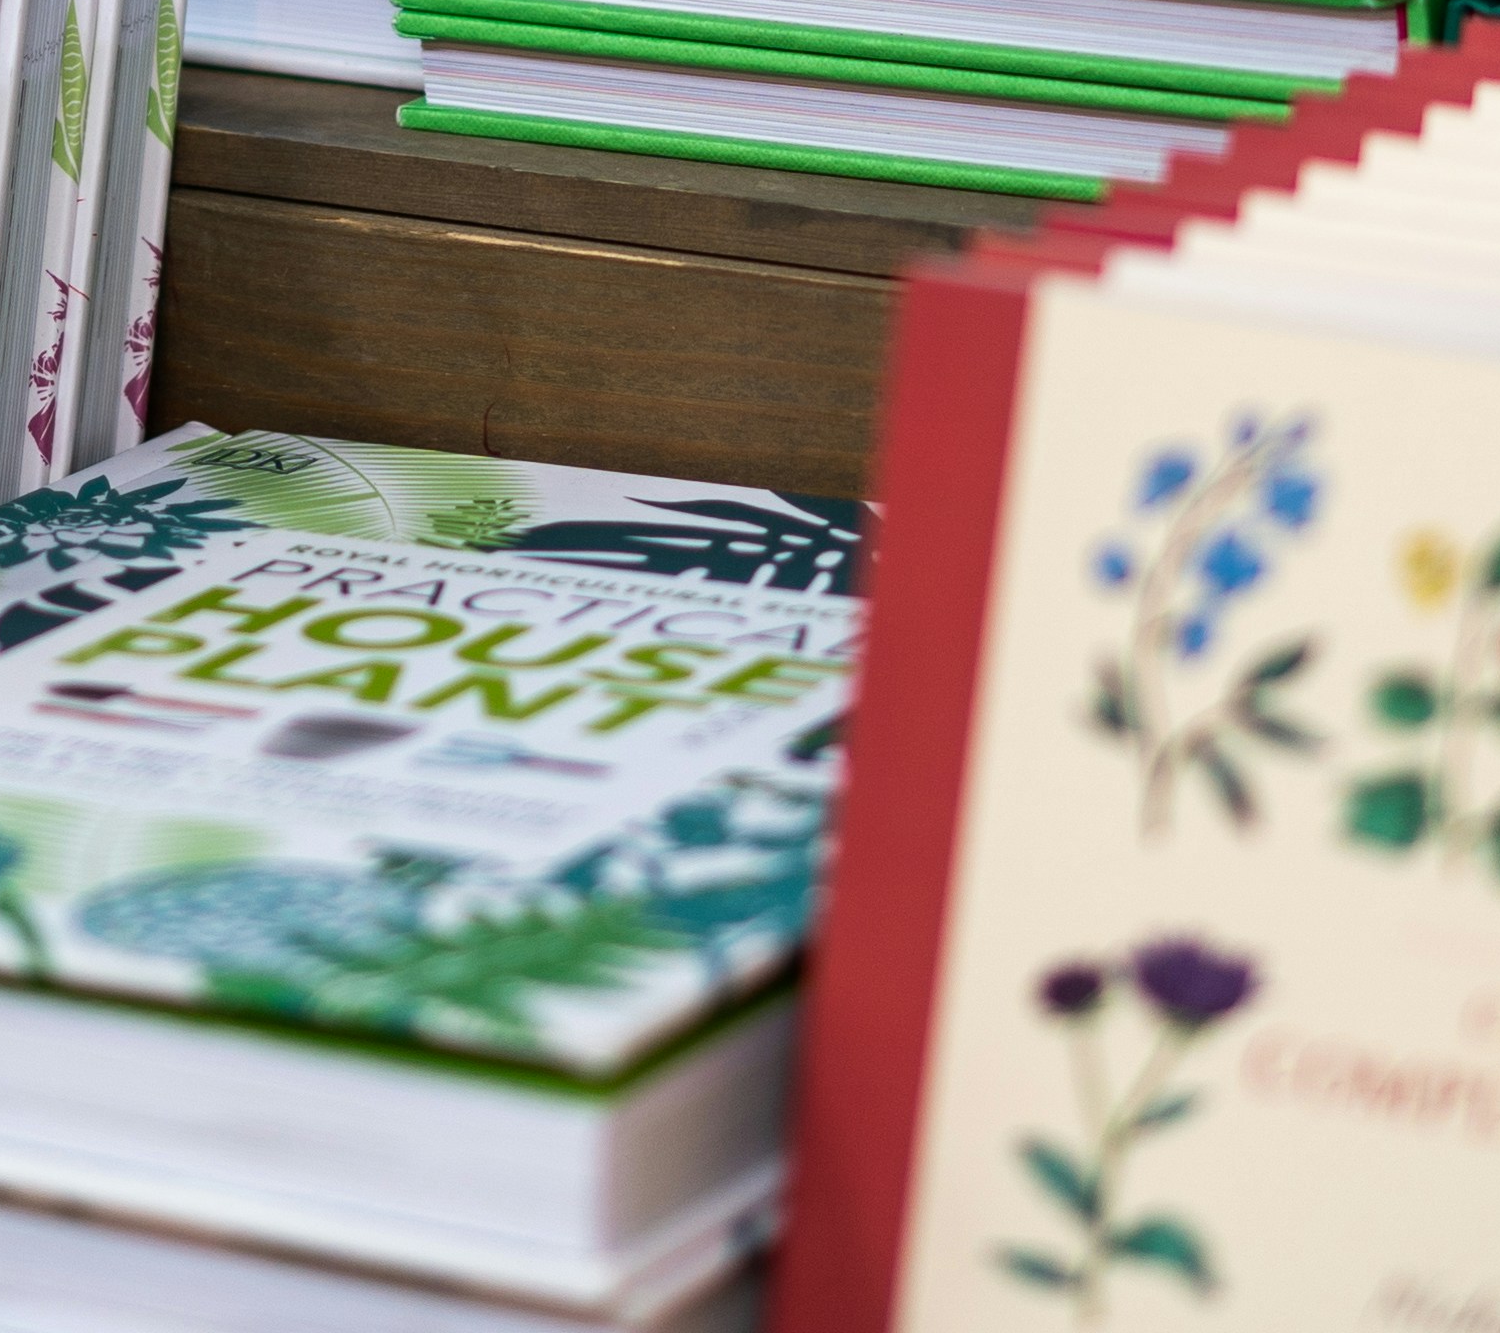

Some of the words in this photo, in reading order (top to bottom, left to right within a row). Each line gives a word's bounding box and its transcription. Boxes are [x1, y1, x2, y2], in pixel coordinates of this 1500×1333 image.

[285, 542, 411, 568] ROYAL
[56, 624, 715, 737] PLANT
[146, 585, 852, 706] HOUSE
